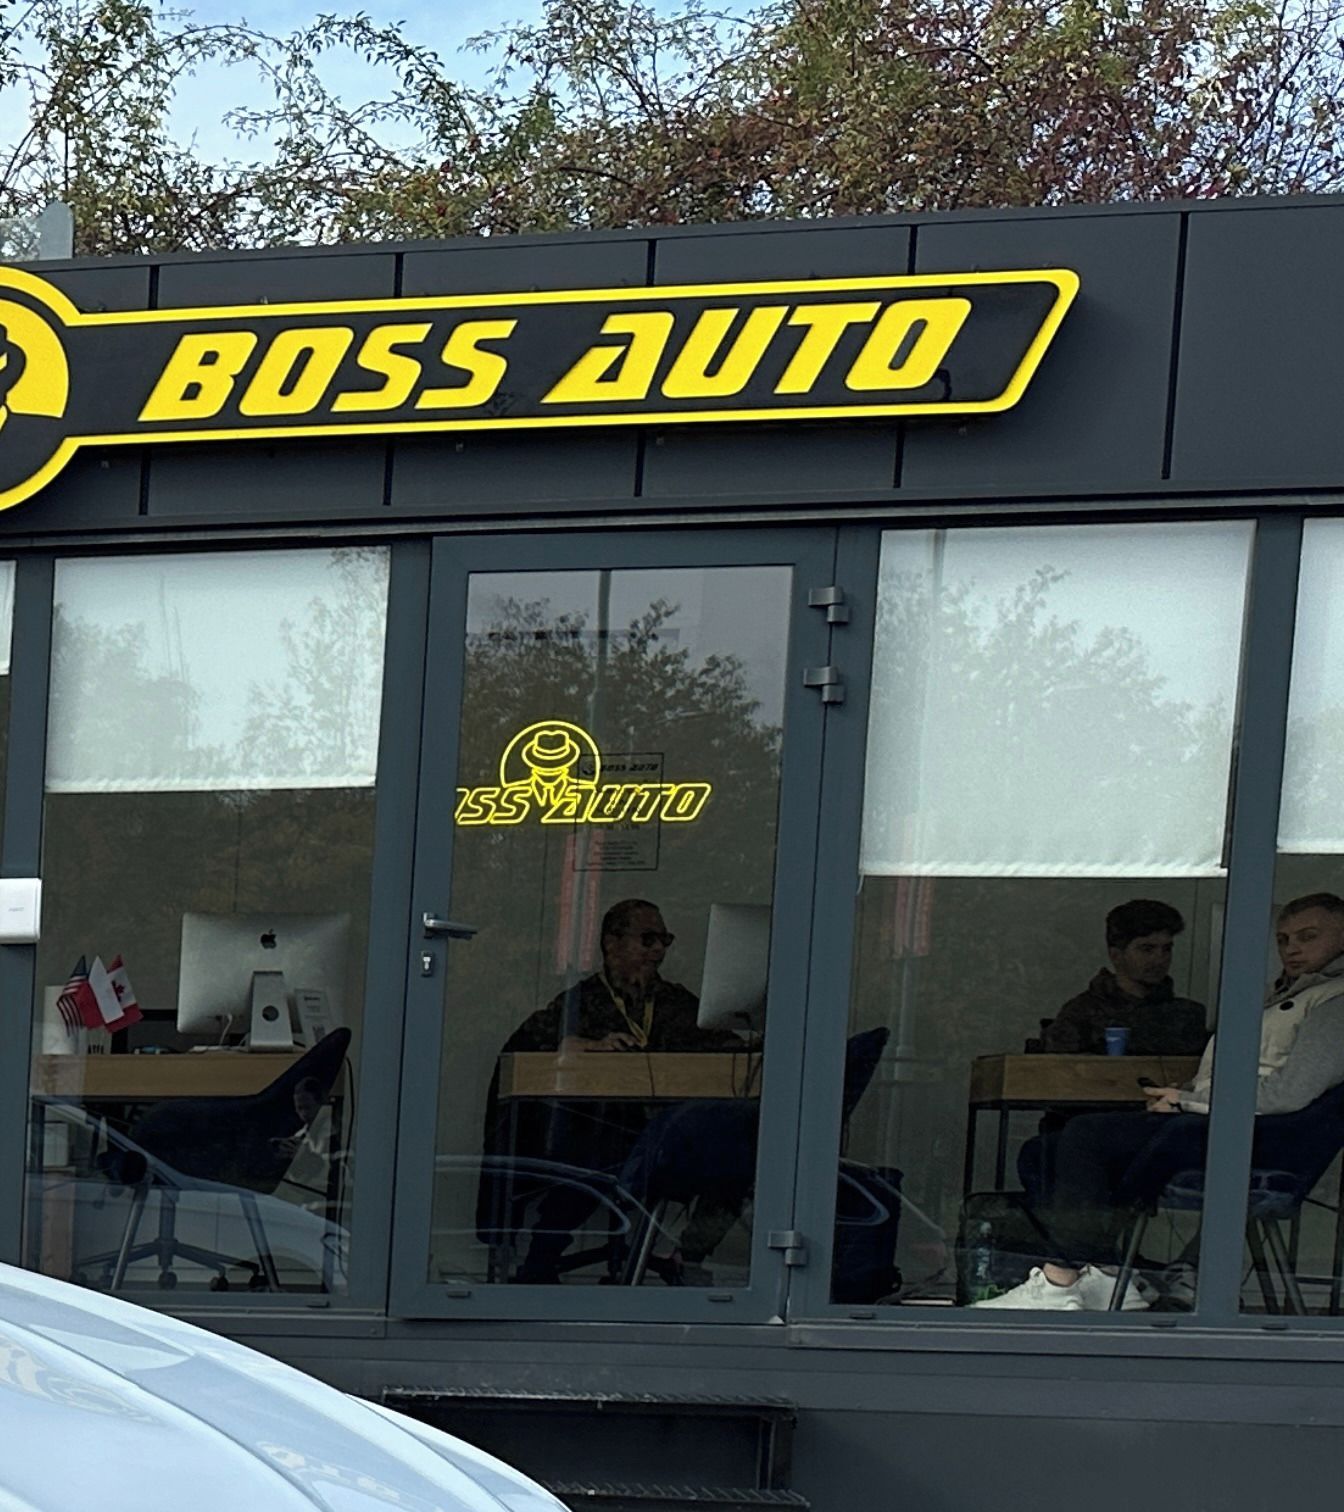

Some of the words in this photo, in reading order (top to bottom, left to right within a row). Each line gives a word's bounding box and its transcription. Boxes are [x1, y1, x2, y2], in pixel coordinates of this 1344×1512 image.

[138, 319, 518, 422] BOSS
[540, 297, 973, 404] AUTO
[541, 782, 711, 823] AUTO
